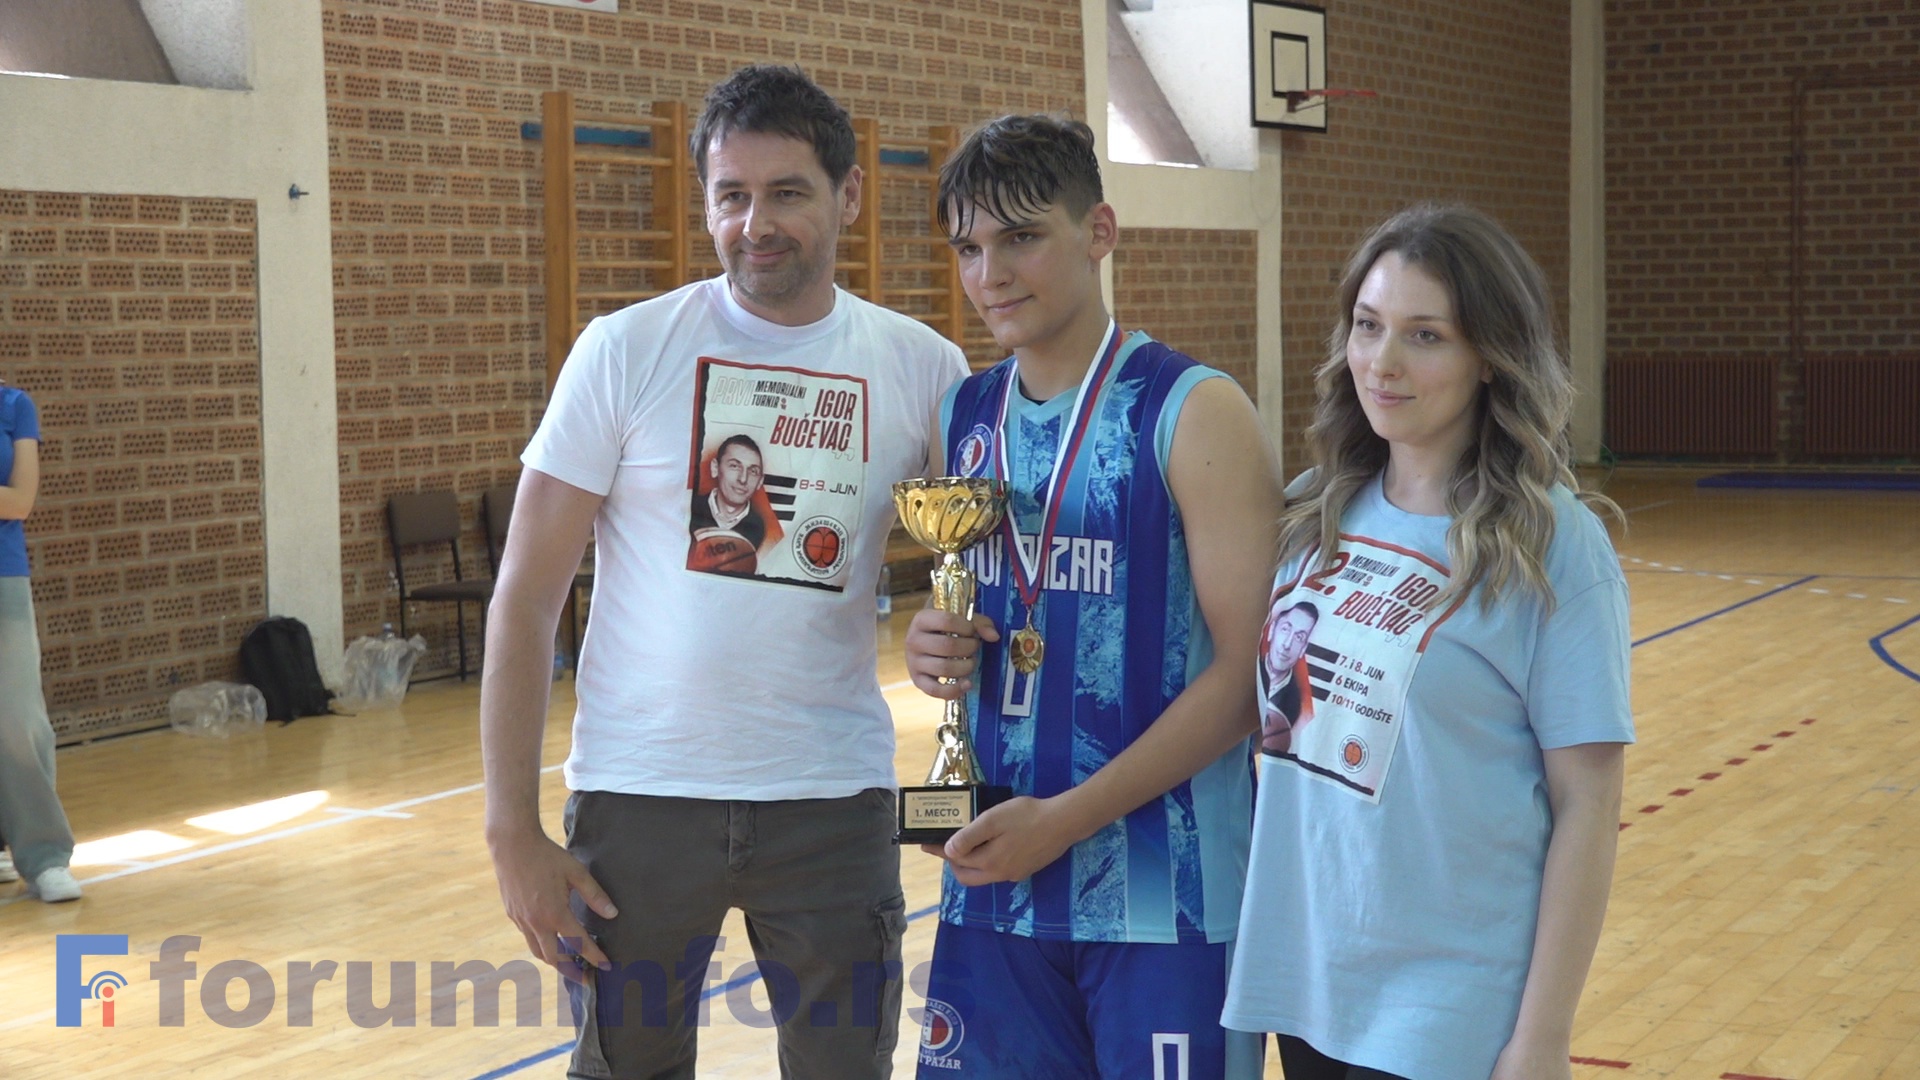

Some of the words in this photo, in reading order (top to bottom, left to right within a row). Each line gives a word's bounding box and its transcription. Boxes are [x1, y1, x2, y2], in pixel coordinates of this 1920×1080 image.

[711, 375, 754, 407] PRVI
[751, 394, 780, 408] TURNIR
[755, 380, 807, 400] MEMORIJALNI
[813, 388, 857, 421] IGOR
[829, 483, 858, 496] JUN
[1302, 552, 1350, 595] 2.
[1338, 567, 1367, 584] TURNIR
[1348, 555, 1401, 577] MEMORIJALNI
[1389, 573, 1440, 611] IGO
[1339, 655, 1347, 668] 7.
[1349, 659, 1355, 669] i
[1355, 661, 1363, 673] 8.
[1363, 666, 1385, 681] JUN
[1335, 675, 1343, 685] 6
[1343, 677, 1369, 697] EKIPA
[1331, 694, 1355, 710] 10/11
[1355, 703, 1394, 724] GODIŠTE
[915, 808, 922, 817] 1.
[925, 808, 960, 817] МЕСТО
